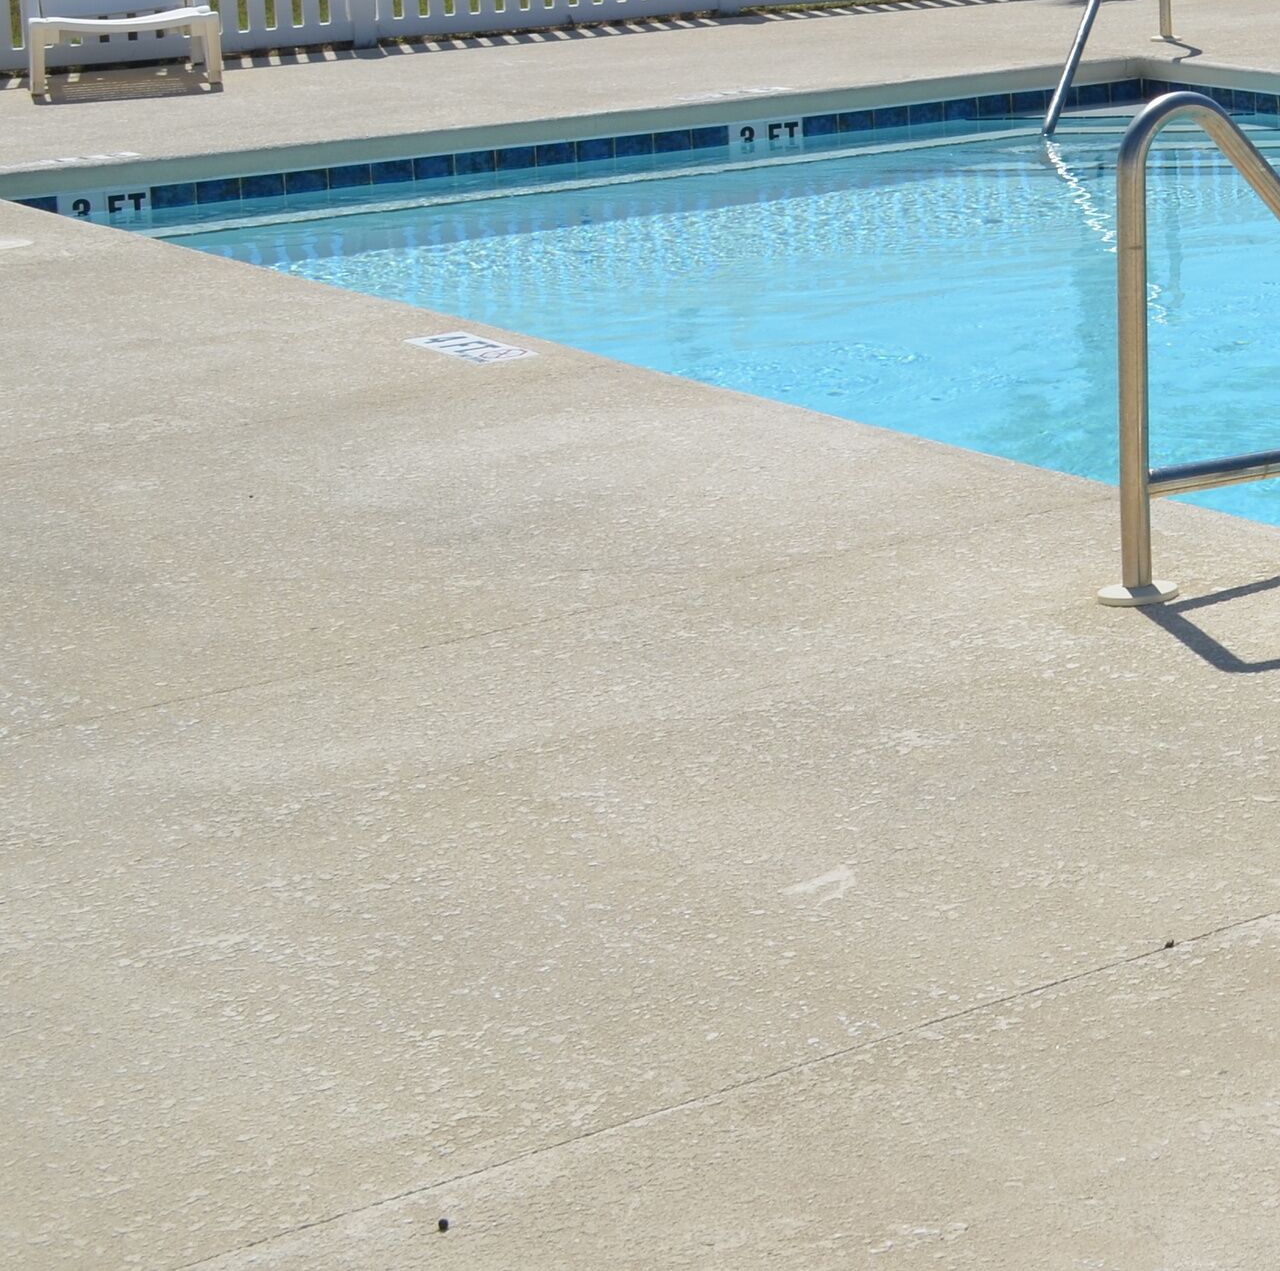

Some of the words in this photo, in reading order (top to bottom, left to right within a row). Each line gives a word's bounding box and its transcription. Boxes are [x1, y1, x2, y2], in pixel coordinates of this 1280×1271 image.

[768, 121, 799, 141] FT
[107, 192, 146, 213] FT
[423, 335, 468, 344] 4
